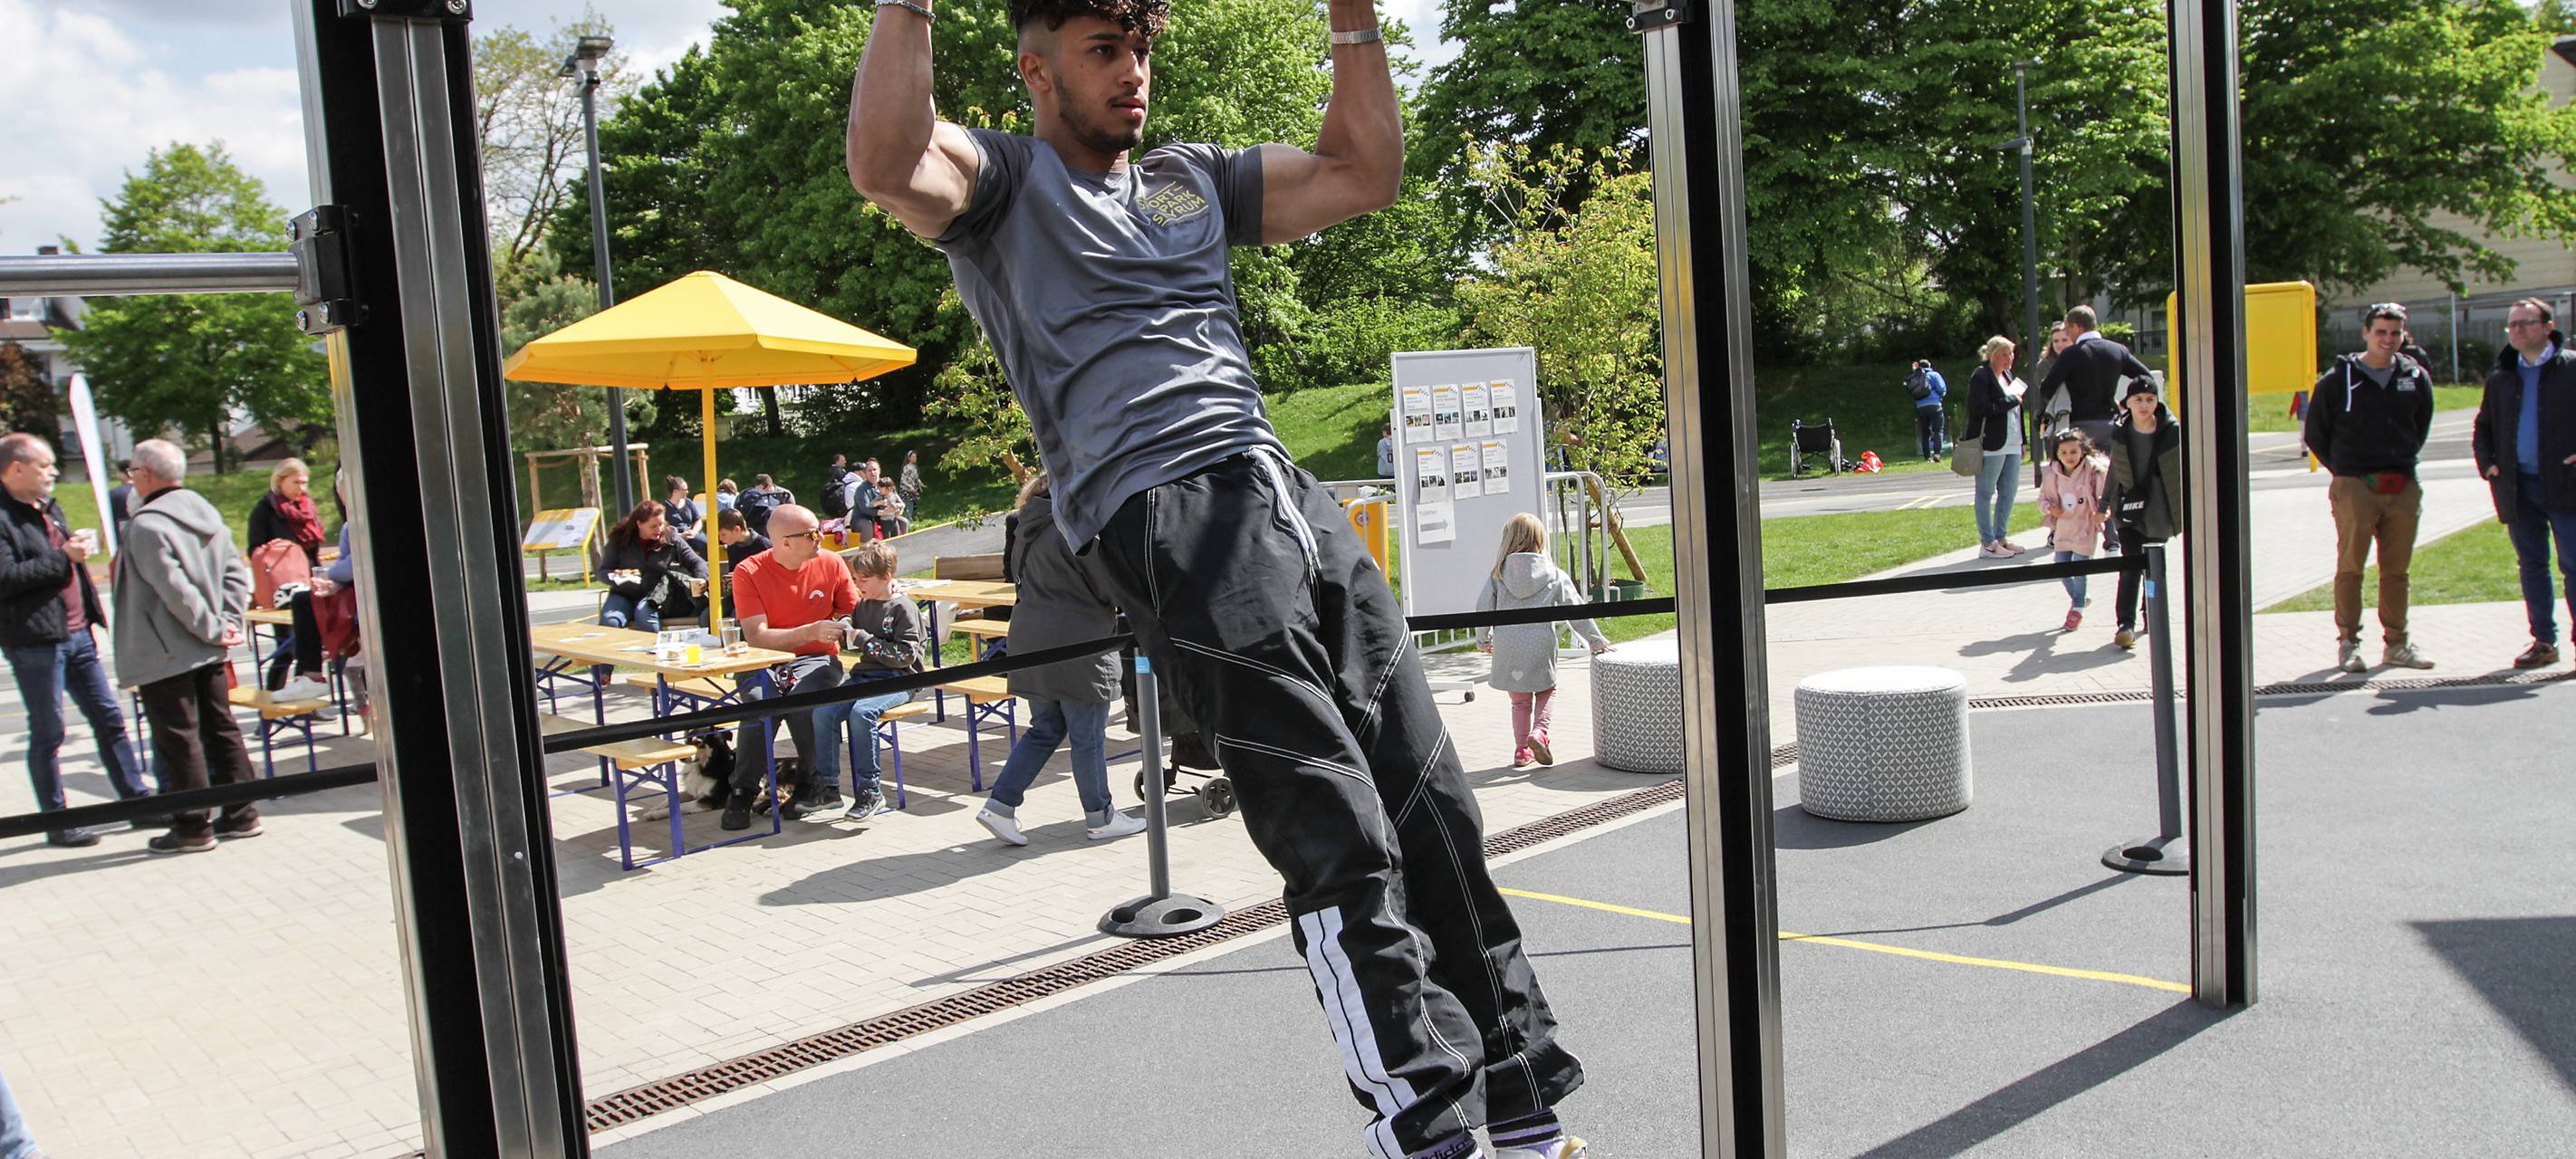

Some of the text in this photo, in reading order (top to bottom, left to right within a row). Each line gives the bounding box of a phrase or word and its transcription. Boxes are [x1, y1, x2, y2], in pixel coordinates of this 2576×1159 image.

[1134, 186, 1183, 210] SORT-
[1158, 190, 1196, 212] PARK
[1152, 196, 1206, 225] SYRUM
[2123, 501, 2145, 511] NIKE
